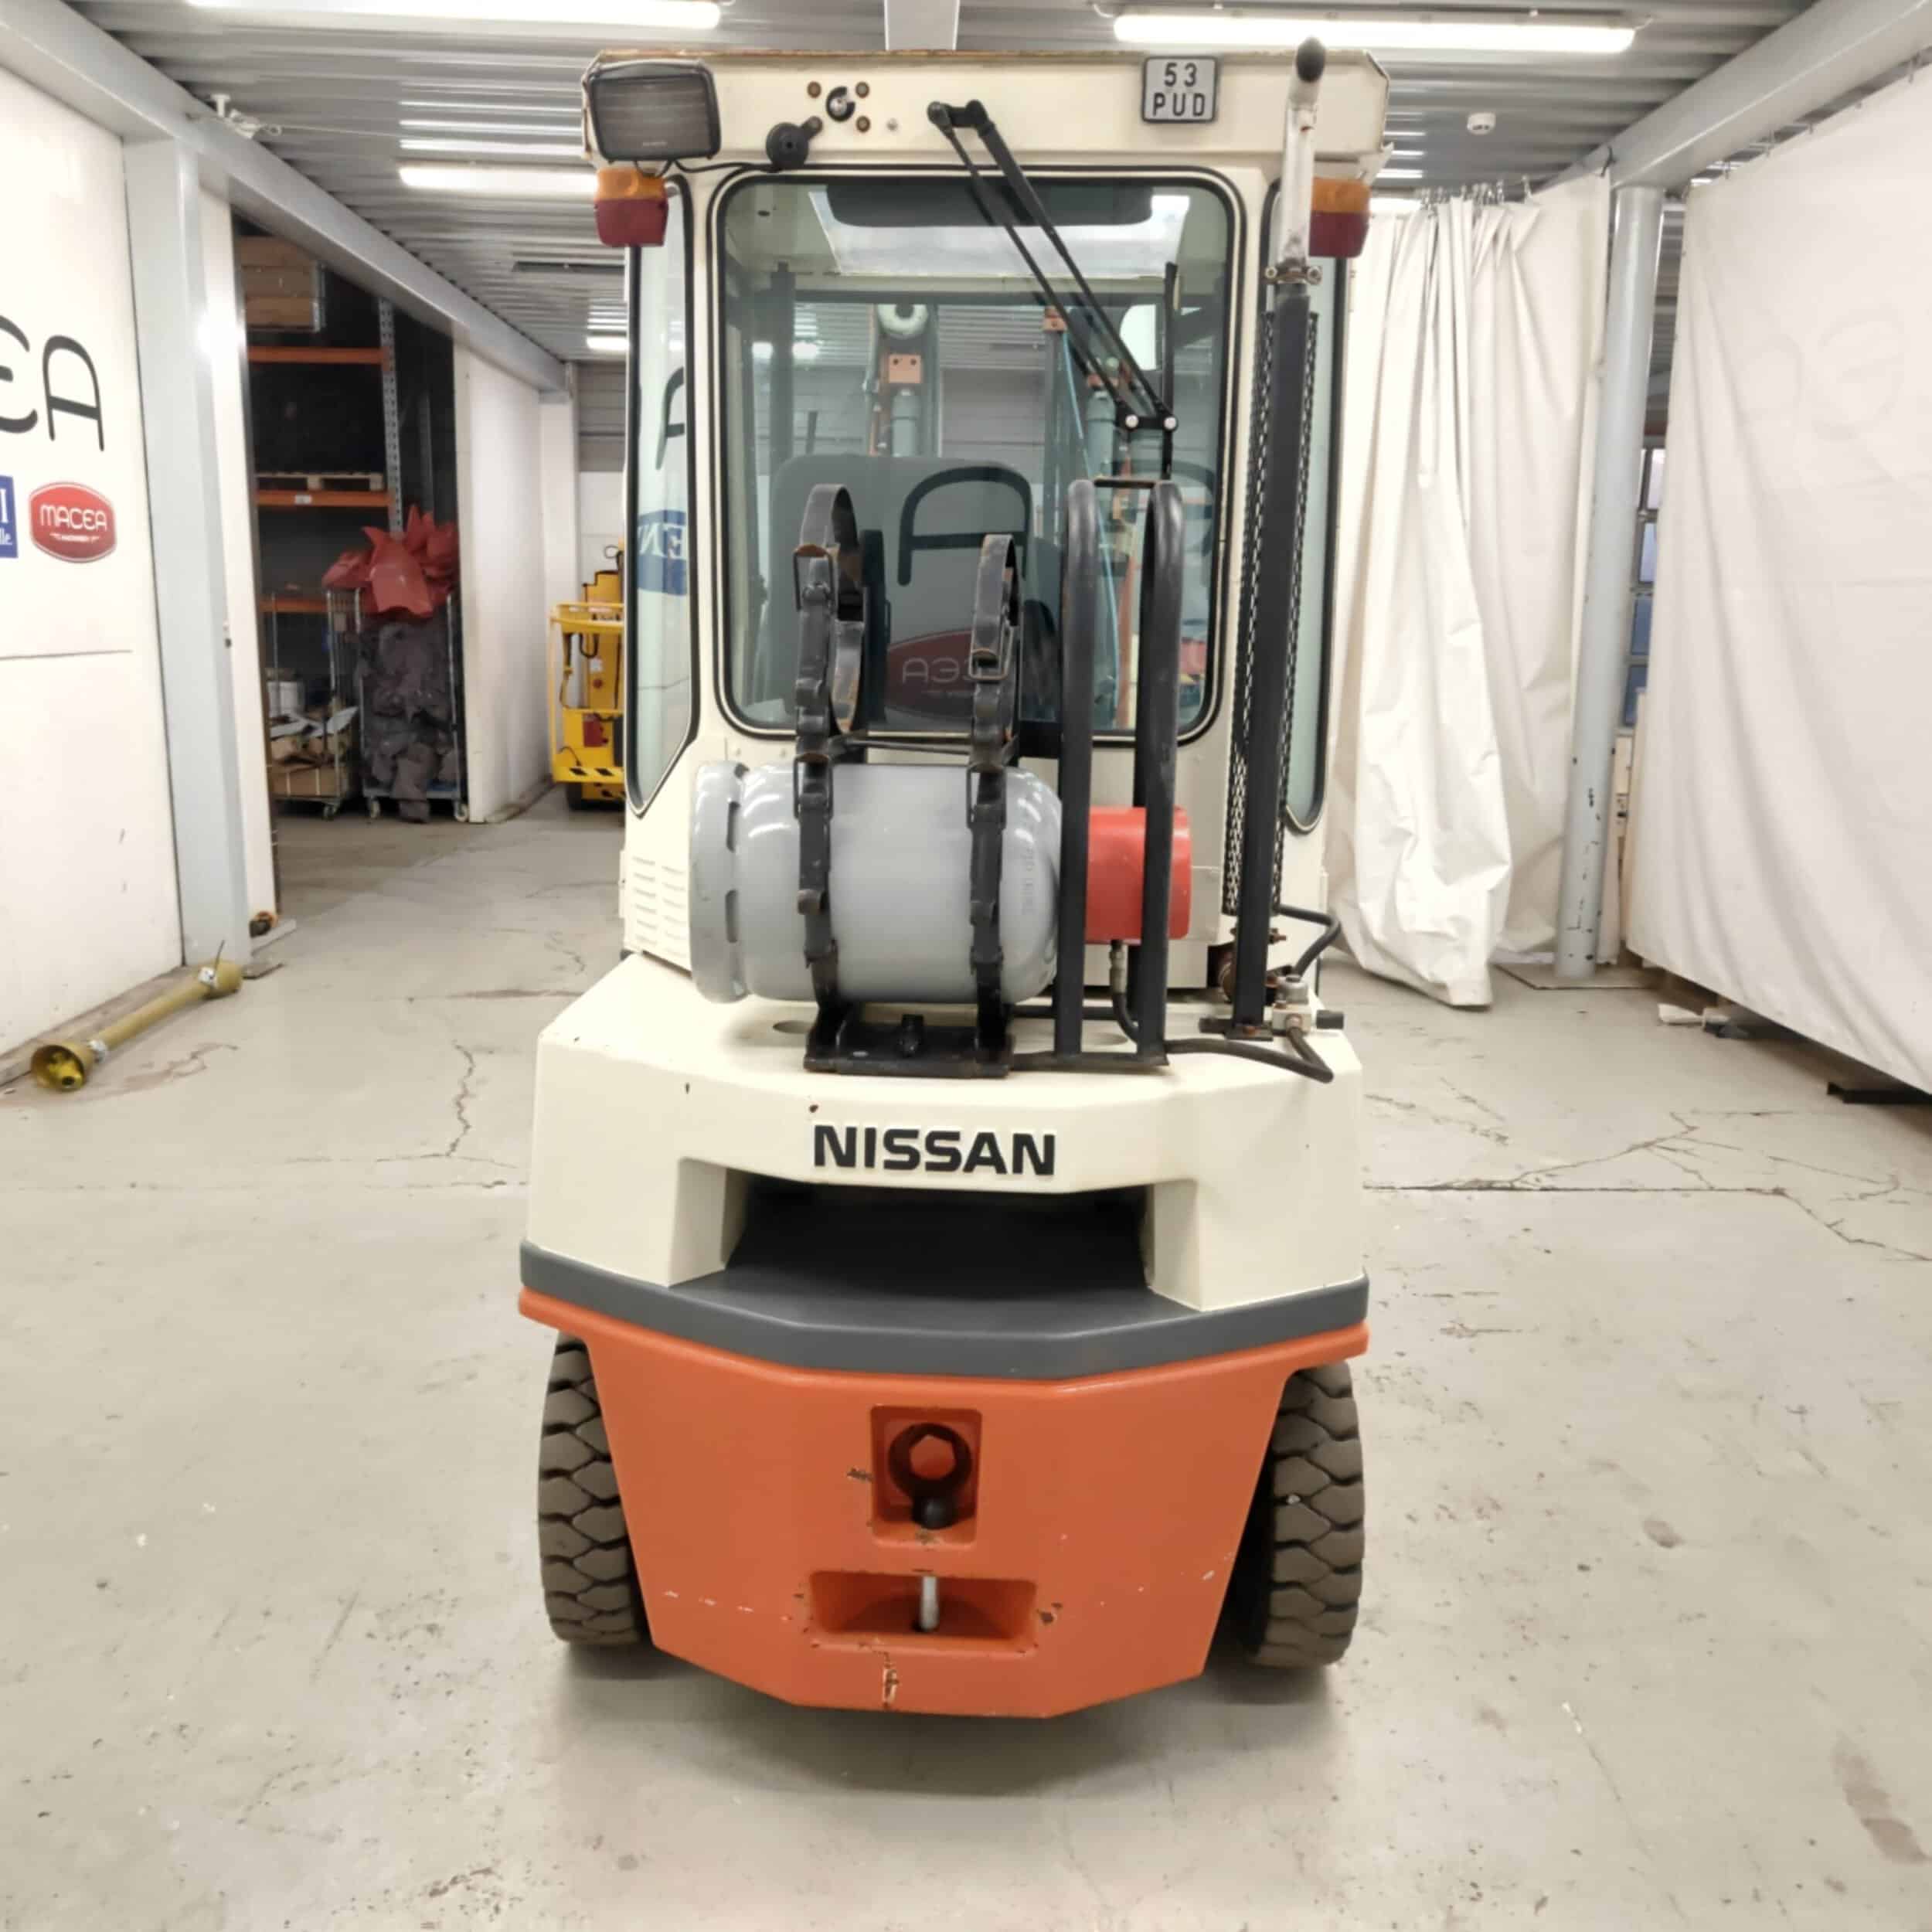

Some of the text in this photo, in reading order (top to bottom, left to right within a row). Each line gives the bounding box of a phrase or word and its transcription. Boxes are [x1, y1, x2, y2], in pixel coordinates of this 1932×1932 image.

[1164, 62, 1197, 87] 53
[1152, 92, 1206, 117] PUD
[39, 504, 108, 532] MACEA
[814, 1124, 1056, 1176] NISSAN
